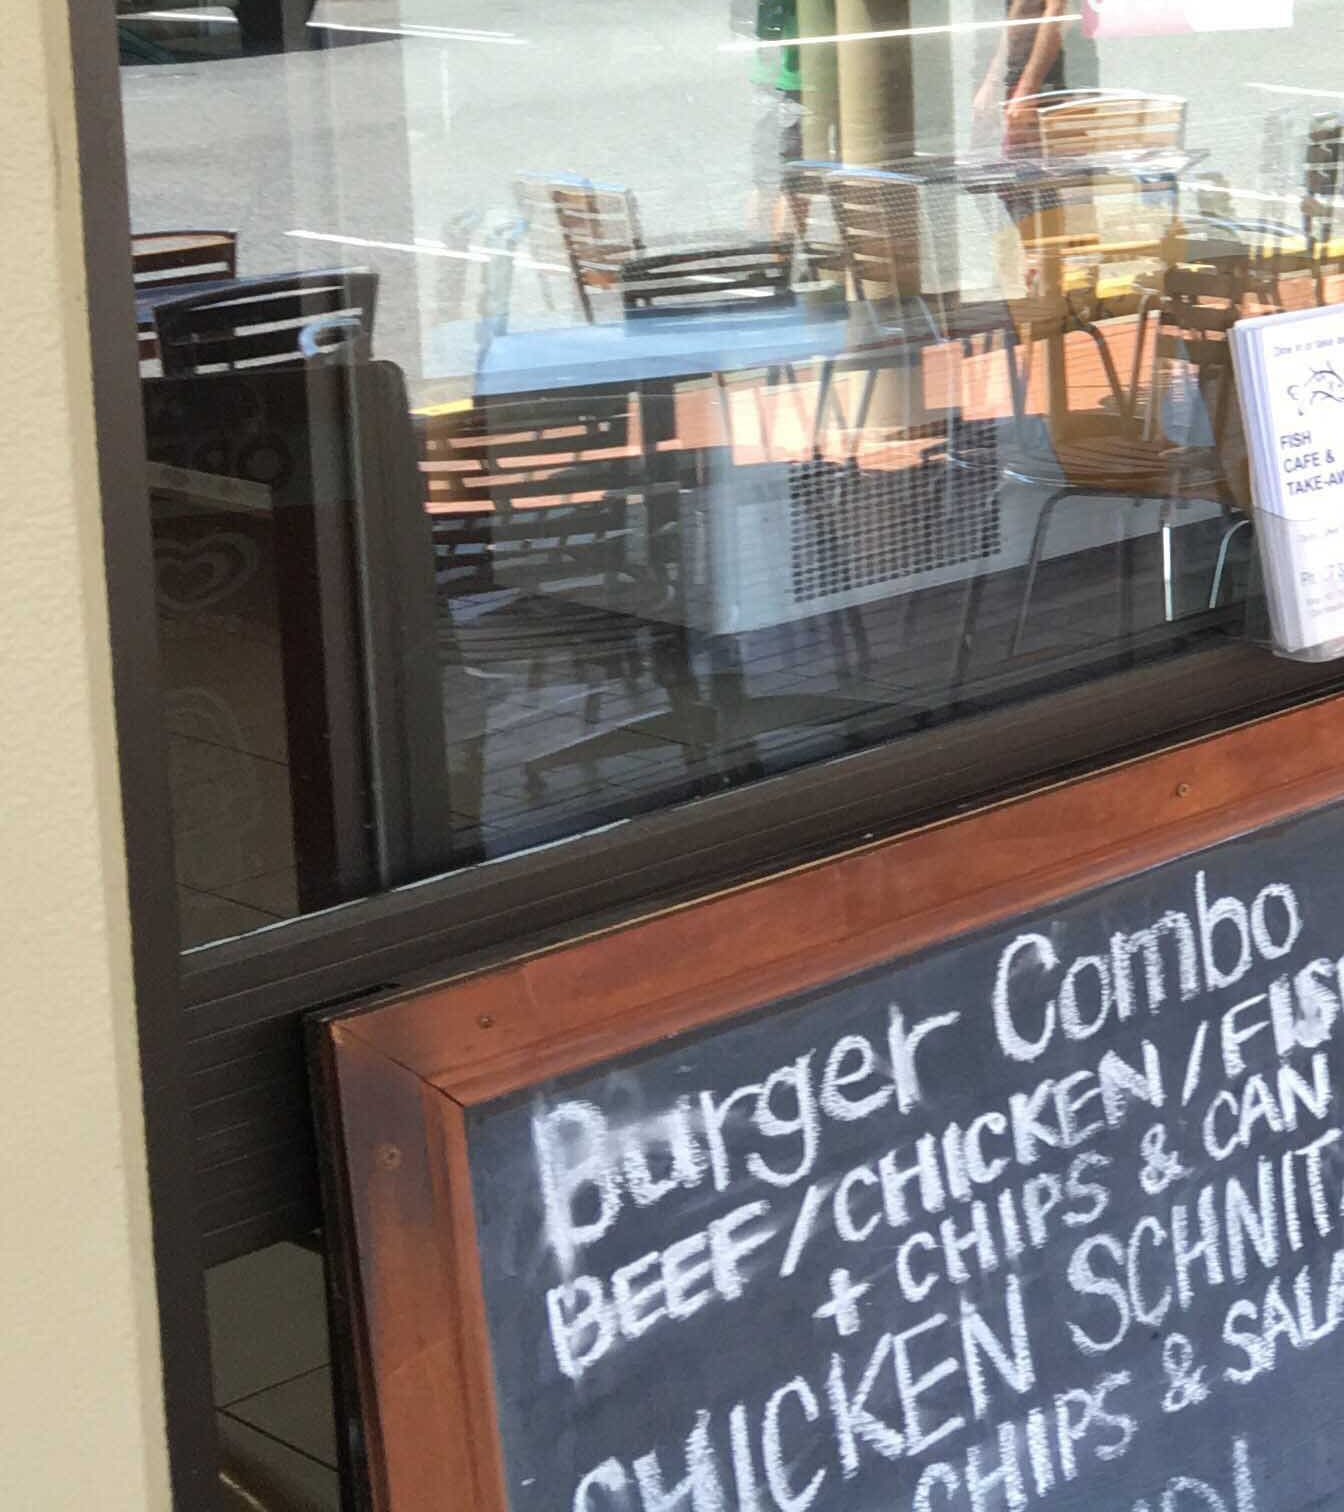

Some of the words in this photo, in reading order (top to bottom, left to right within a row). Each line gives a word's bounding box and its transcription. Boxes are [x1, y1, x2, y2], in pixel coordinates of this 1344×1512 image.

[1280, 430, 1312, 450] FISH
[1283, 451, 1321, 473] CAFE
[531, 1001, 961, 1268] Burger
[991, 869, 1302, 1063] Combo
[896, 1150, 1113, 1303] CHIPS
[1138, 1122, 1195, 1196] &
[1202, 1053, 1334, 1162] CAN
[913, 1368, 1139, 1512] CHIPS
[1160, 1331, 1212, 1414] &
